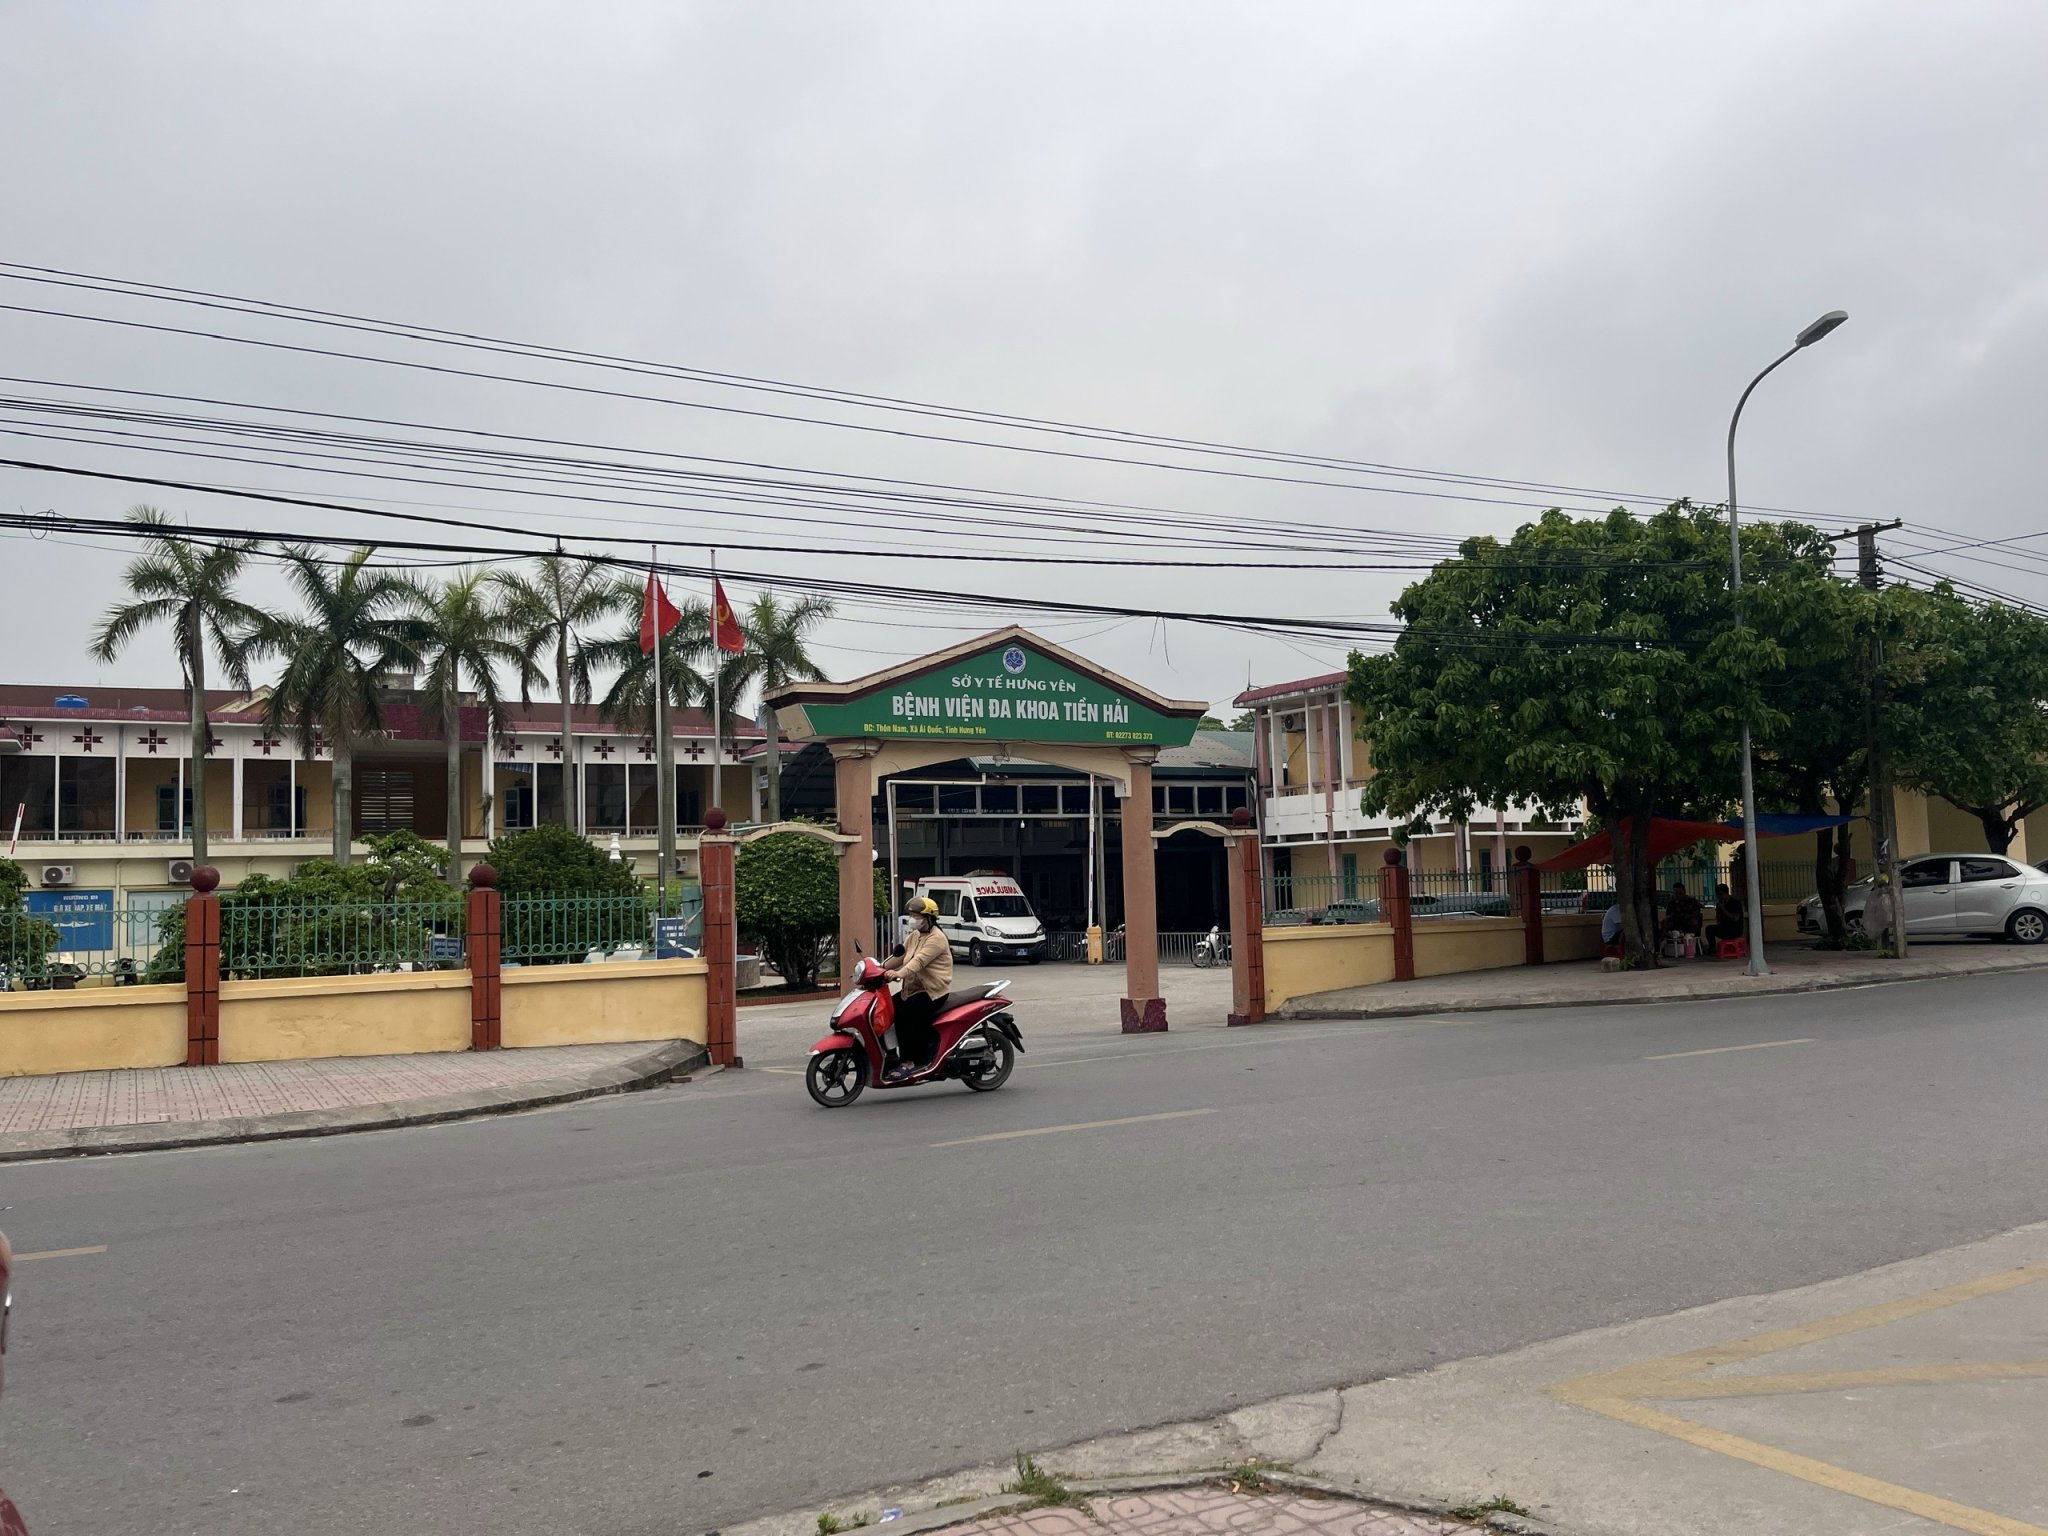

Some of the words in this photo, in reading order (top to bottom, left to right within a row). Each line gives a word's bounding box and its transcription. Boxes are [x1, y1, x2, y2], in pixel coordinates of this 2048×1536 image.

[951, 673, 971, 688] SỞ
[974, 678, 984, 688] Y
[987, 674, 1004, 689] TẾ
[1006, 678, 1047, 691] HƯNG
[1050, 679, 1076, 693] YÊN
[892, 691, 940, 721] BỆNH
[944, 694, 984, 722] VIỆN
[988, 699, 1011, 719] ĐA
[1016, 700, 1060, 721] KHOA
[1063, 696, 1099, 723] TIỀN
[1103, 698, 1129, 724] HẢI
